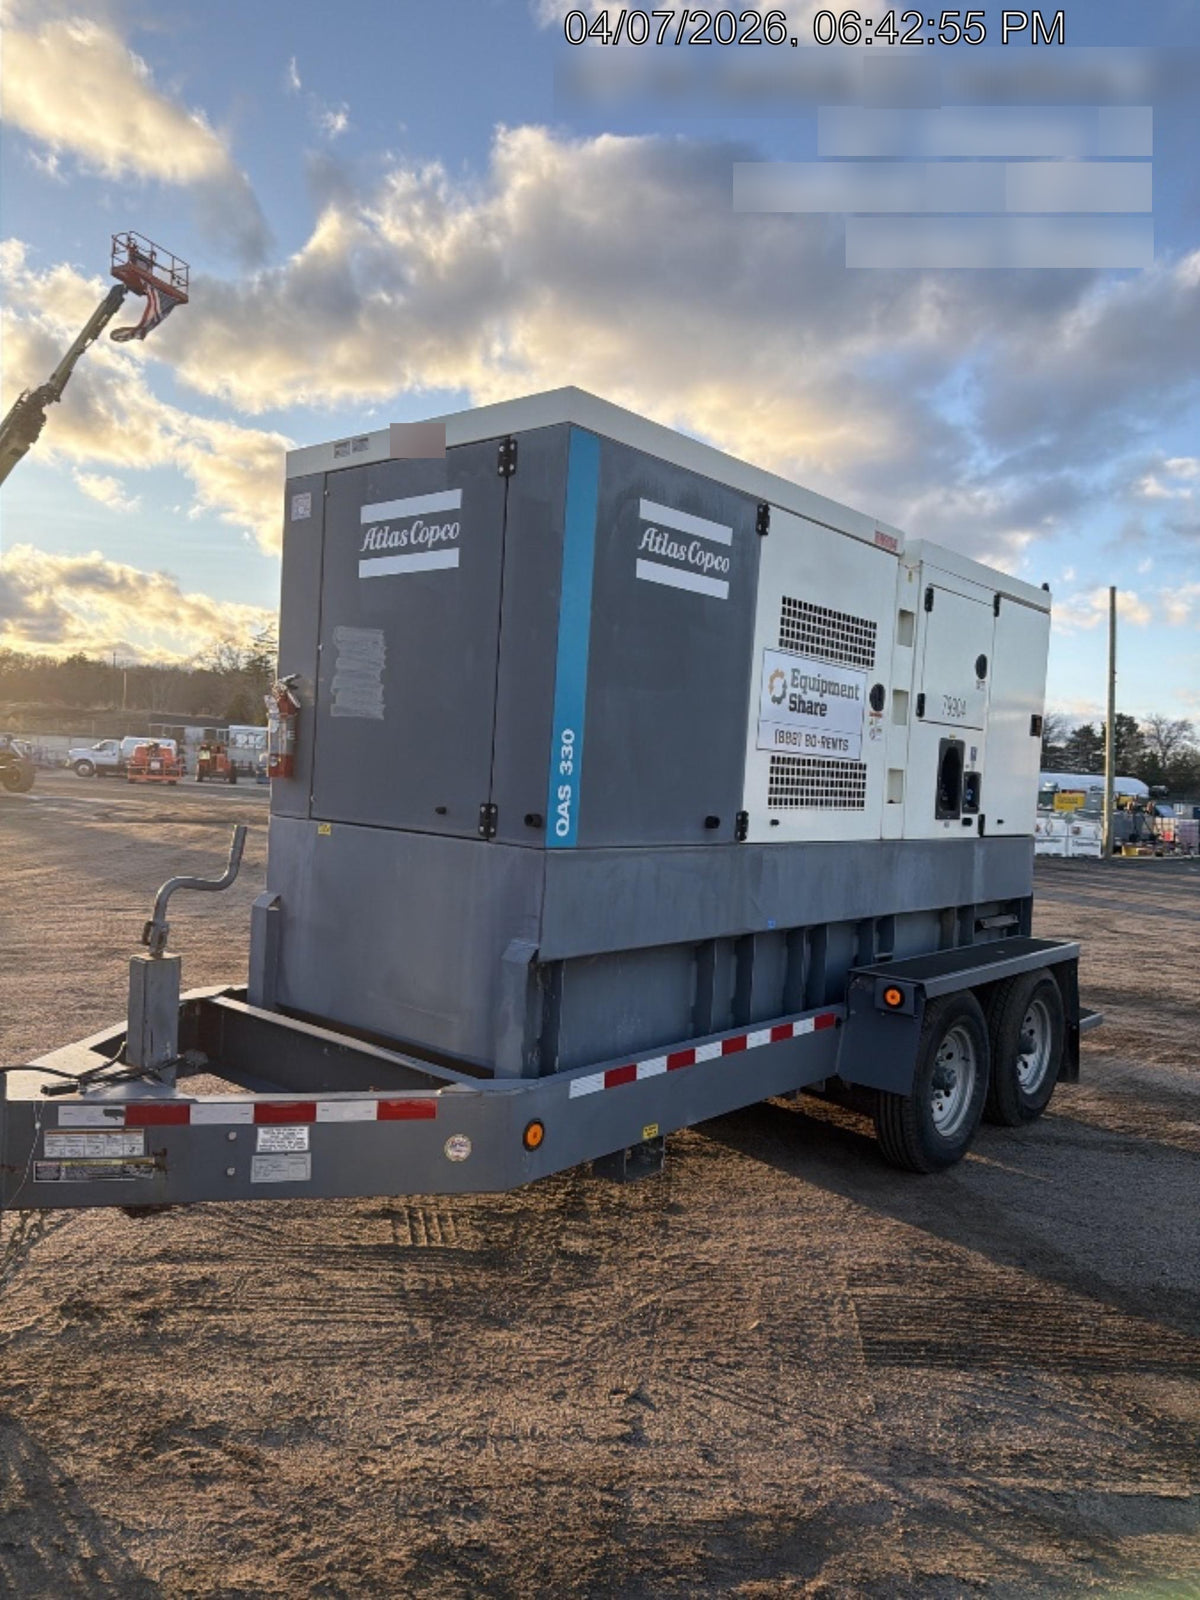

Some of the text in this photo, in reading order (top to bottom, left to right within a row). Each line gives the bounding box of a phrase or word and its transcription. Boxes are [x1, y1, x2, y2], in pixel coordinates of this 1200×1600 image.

[360, 520, 460, 552] Atlas Copco
[638, 527, 730, 573] Atlas Copco
[790, 667, 860, 701] Equipment
[788, 693, 828, 718] Share
[559, 728, 575, 776] 330
